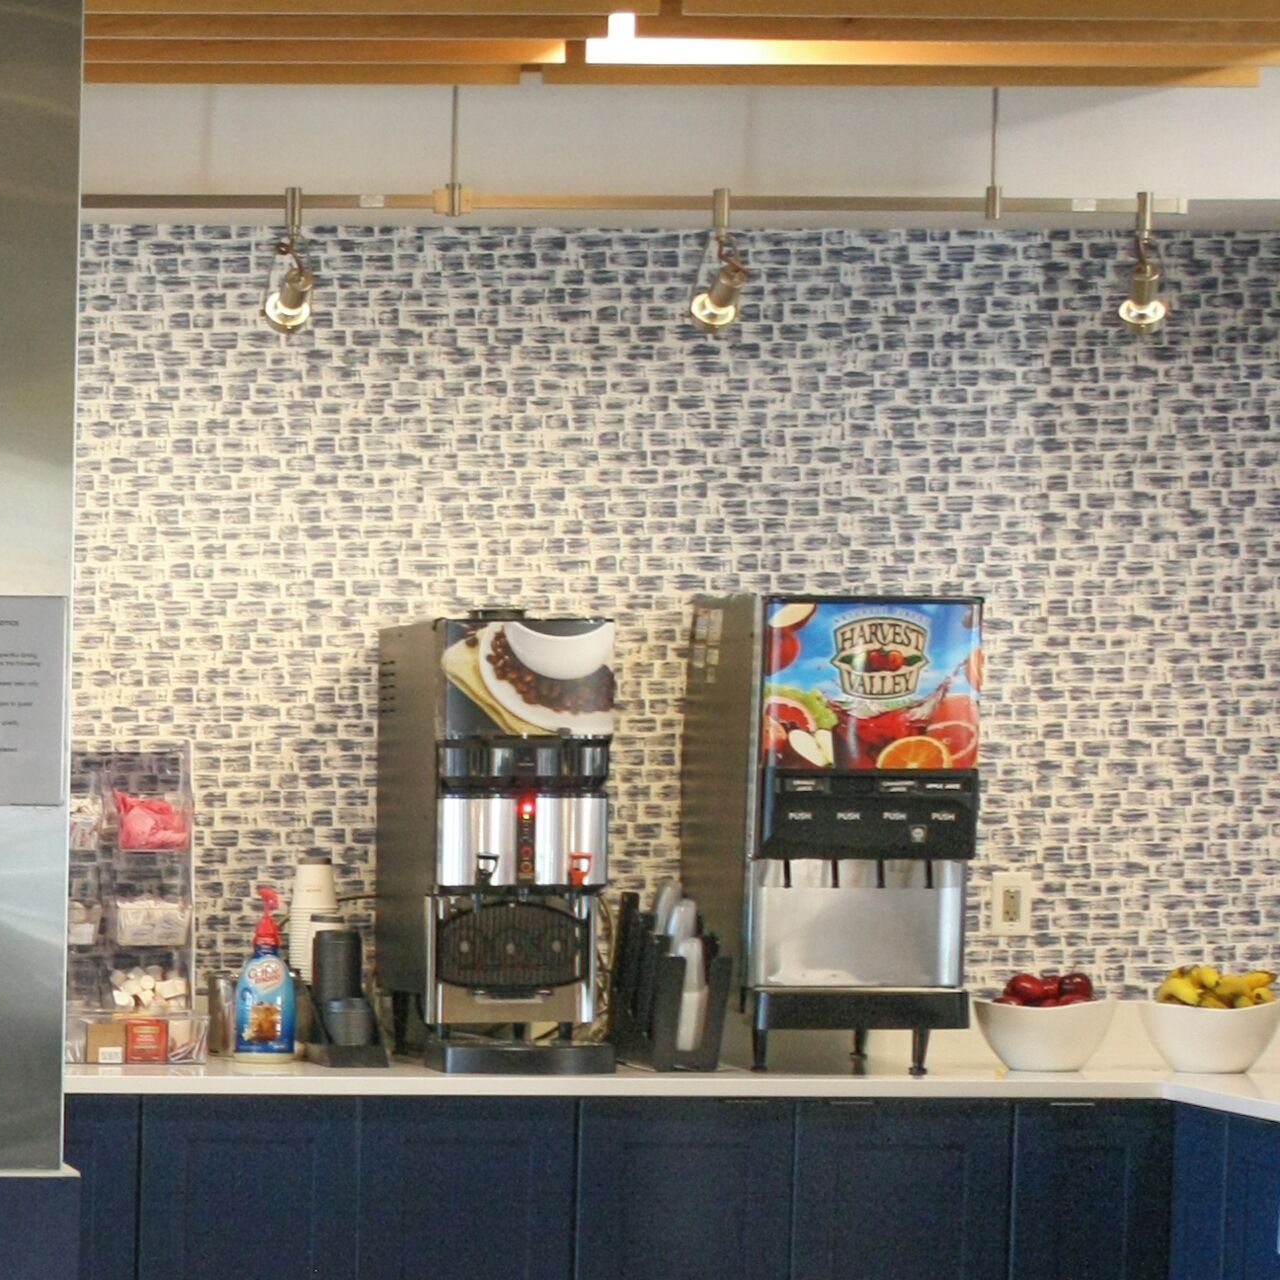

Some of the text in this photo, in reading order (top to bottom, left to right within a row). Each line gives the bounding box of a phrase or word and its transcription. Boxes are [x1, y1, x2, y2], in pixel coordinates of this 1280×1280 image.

[840, 623, 925, 651] HARVEST
[844, 669, 915, 696] VALLEY
[788, 812, 812, 820] PUSH
[836, 812, 861, 821] PUSH
[882, 812, 907, 821] PUSH
[931, 812, 956, 821] PUSH
